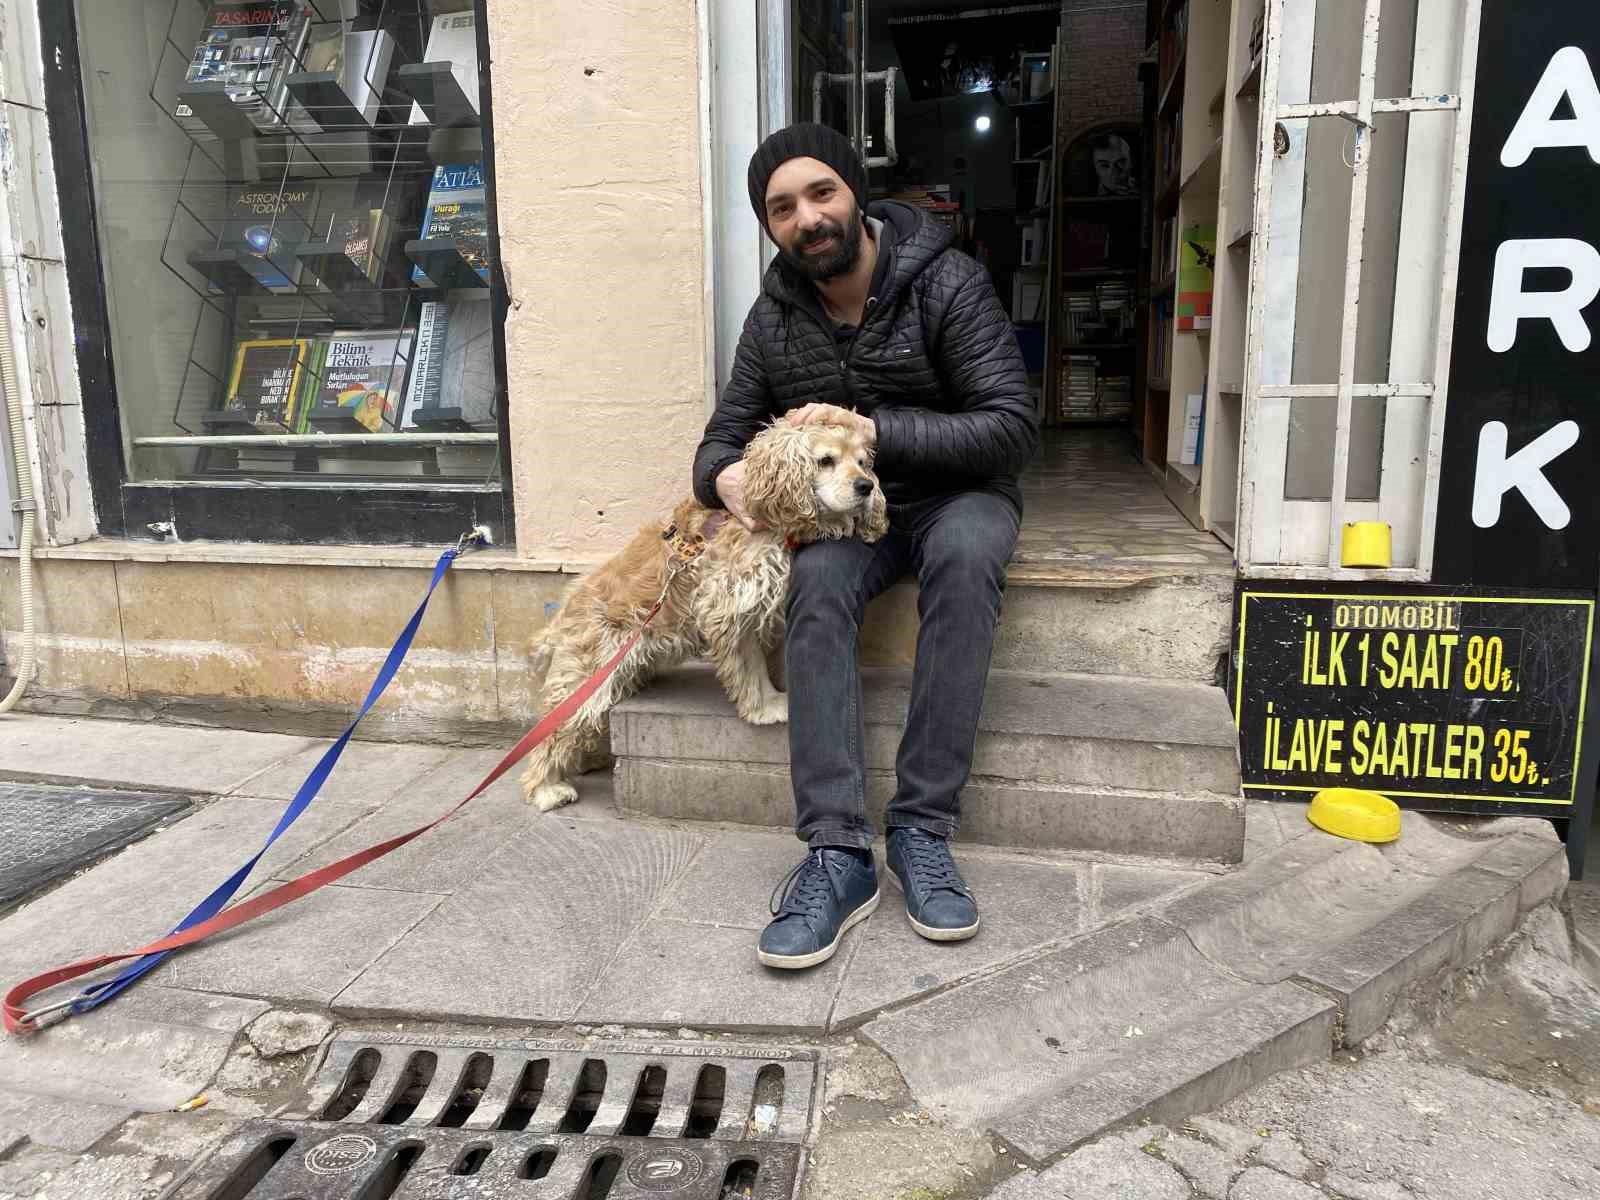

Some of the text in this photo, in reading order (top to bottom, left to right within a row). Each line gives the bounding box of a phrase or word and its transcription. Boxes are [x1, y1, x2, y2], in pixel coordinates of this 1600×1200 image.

[332, 354, 371, 367] Teknik
[333, 342, 366, 354] Bilim
[1335, 604, 1458, 629] OTOMOBİL
[1302, 614, 1351, 687] İLK
[1358, 632, 1371, 687] 1
[1380, 631, 1459, 689] SAAT
[1263, 701, 1345, 773] İLAVE
[1351, 719, 1486, 780] SAATLER
